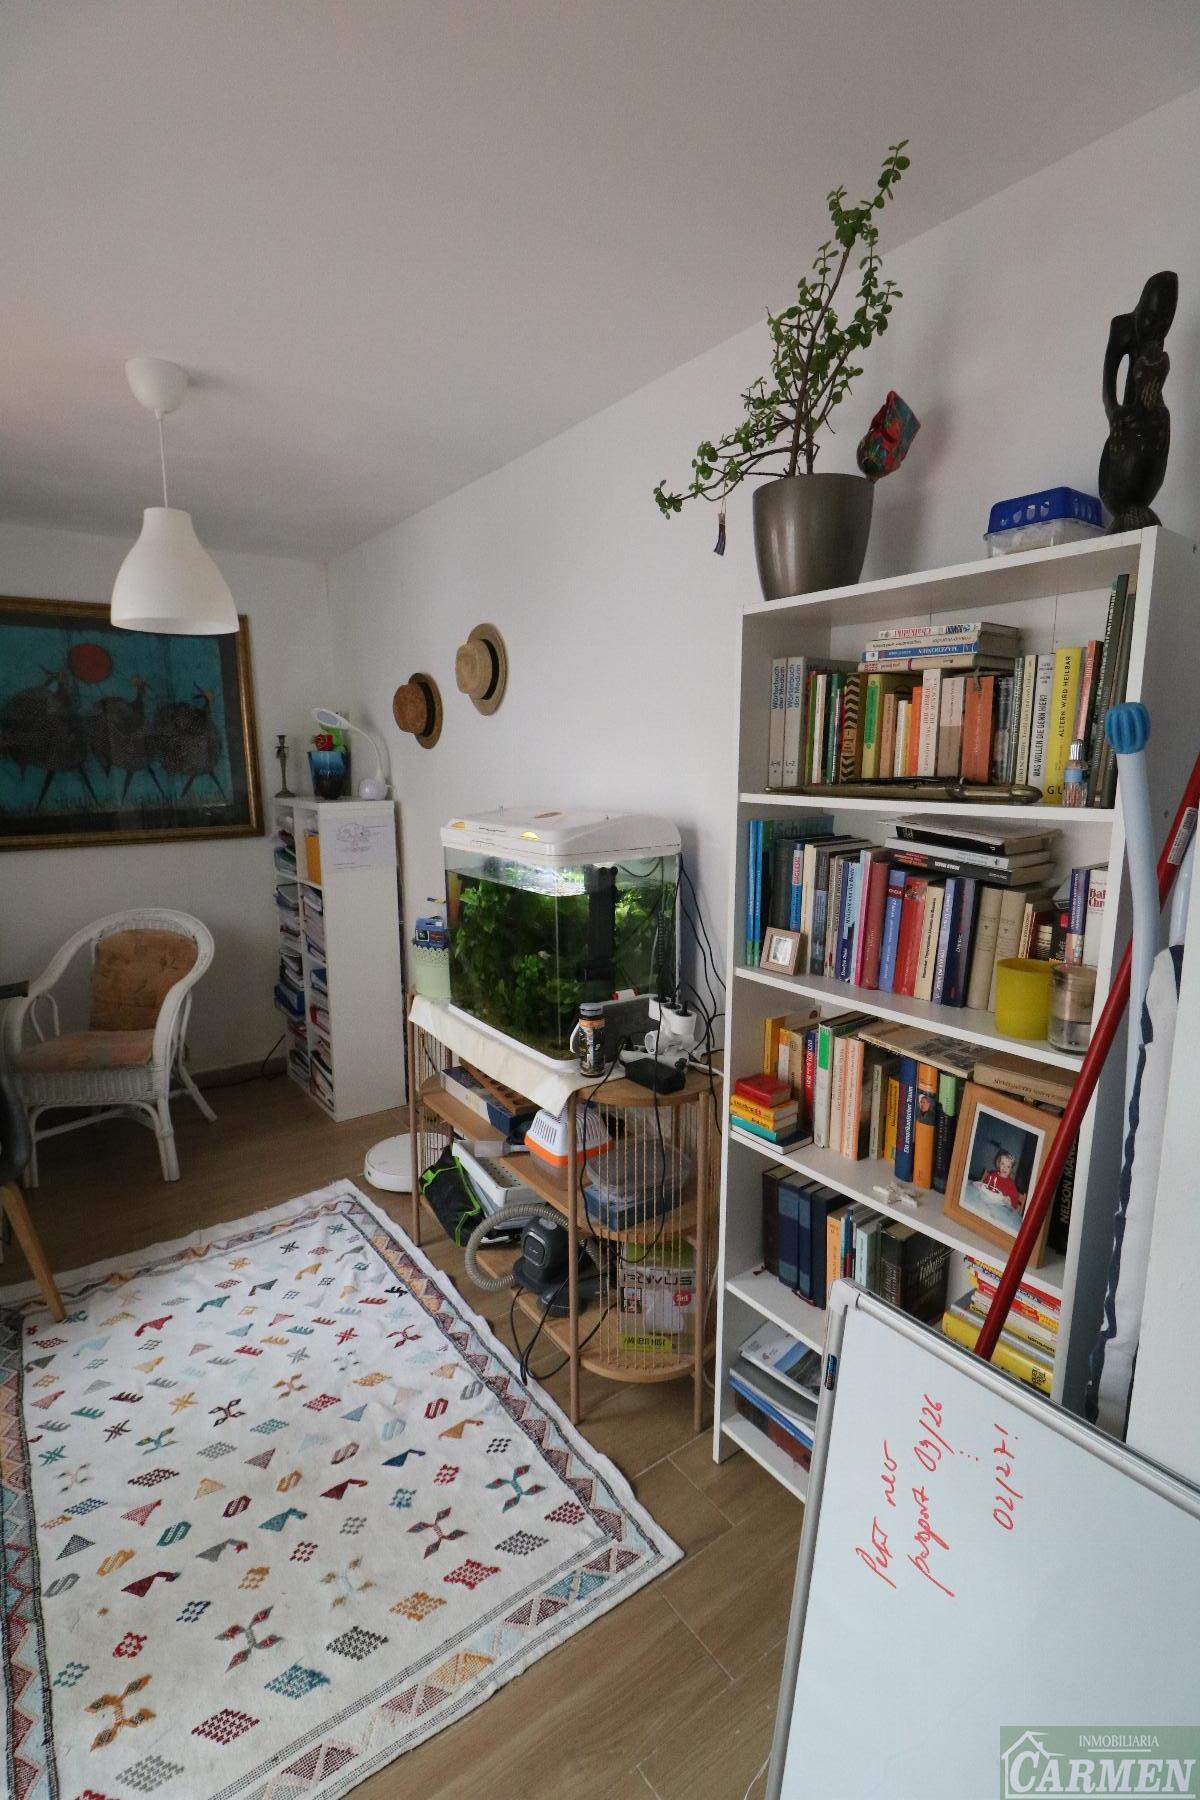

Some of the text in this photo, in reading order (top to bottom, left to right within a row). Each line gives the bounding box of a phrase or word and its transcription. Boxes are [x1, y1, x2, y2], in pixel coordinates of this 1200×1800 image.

[1058, 655, 1071, 738] ALTERN WIRD HEILBAR
[1035, 729, 1044, 739] DIE
[1033, 740, 1043, 764] WOLLEN
[1033, 764, 1041, 777] WAS
[1059, 1181, 1072, 1225] NELSON
